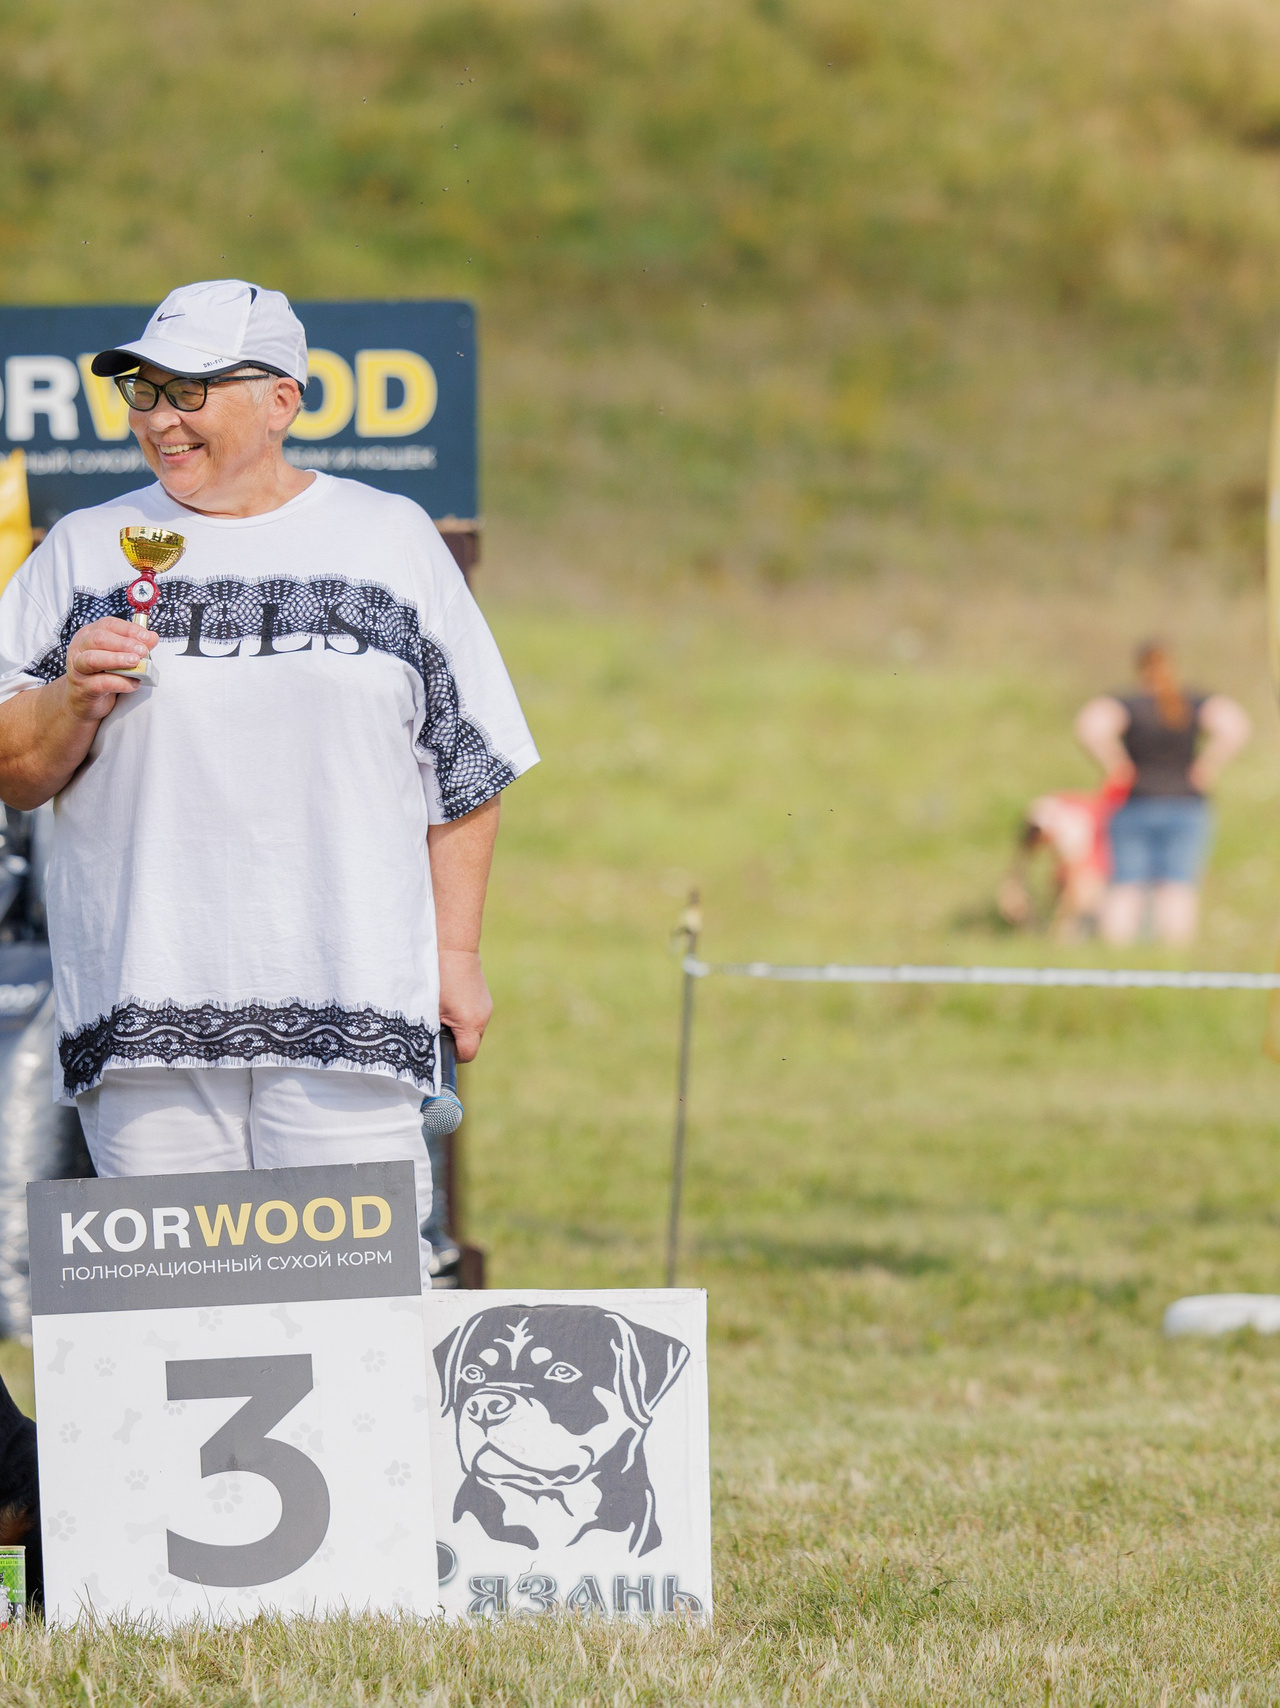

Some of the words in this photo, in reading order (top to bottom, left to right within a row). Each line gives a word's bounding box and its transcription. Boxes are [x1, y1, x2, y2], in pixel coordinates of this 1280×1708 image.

[202, 358, 224, 369] DRI-FIT
[60, 1195, 393, 1255] KORWOOD
[62, 1254, 262, 1282] ПОЛНОРАЦИОННЫЙ
[266, 1250, 332, 1271] СУХОЙ
[337, 1249, 393, 1267] КОРМ
[165, 1353, 330, 1588] 3
